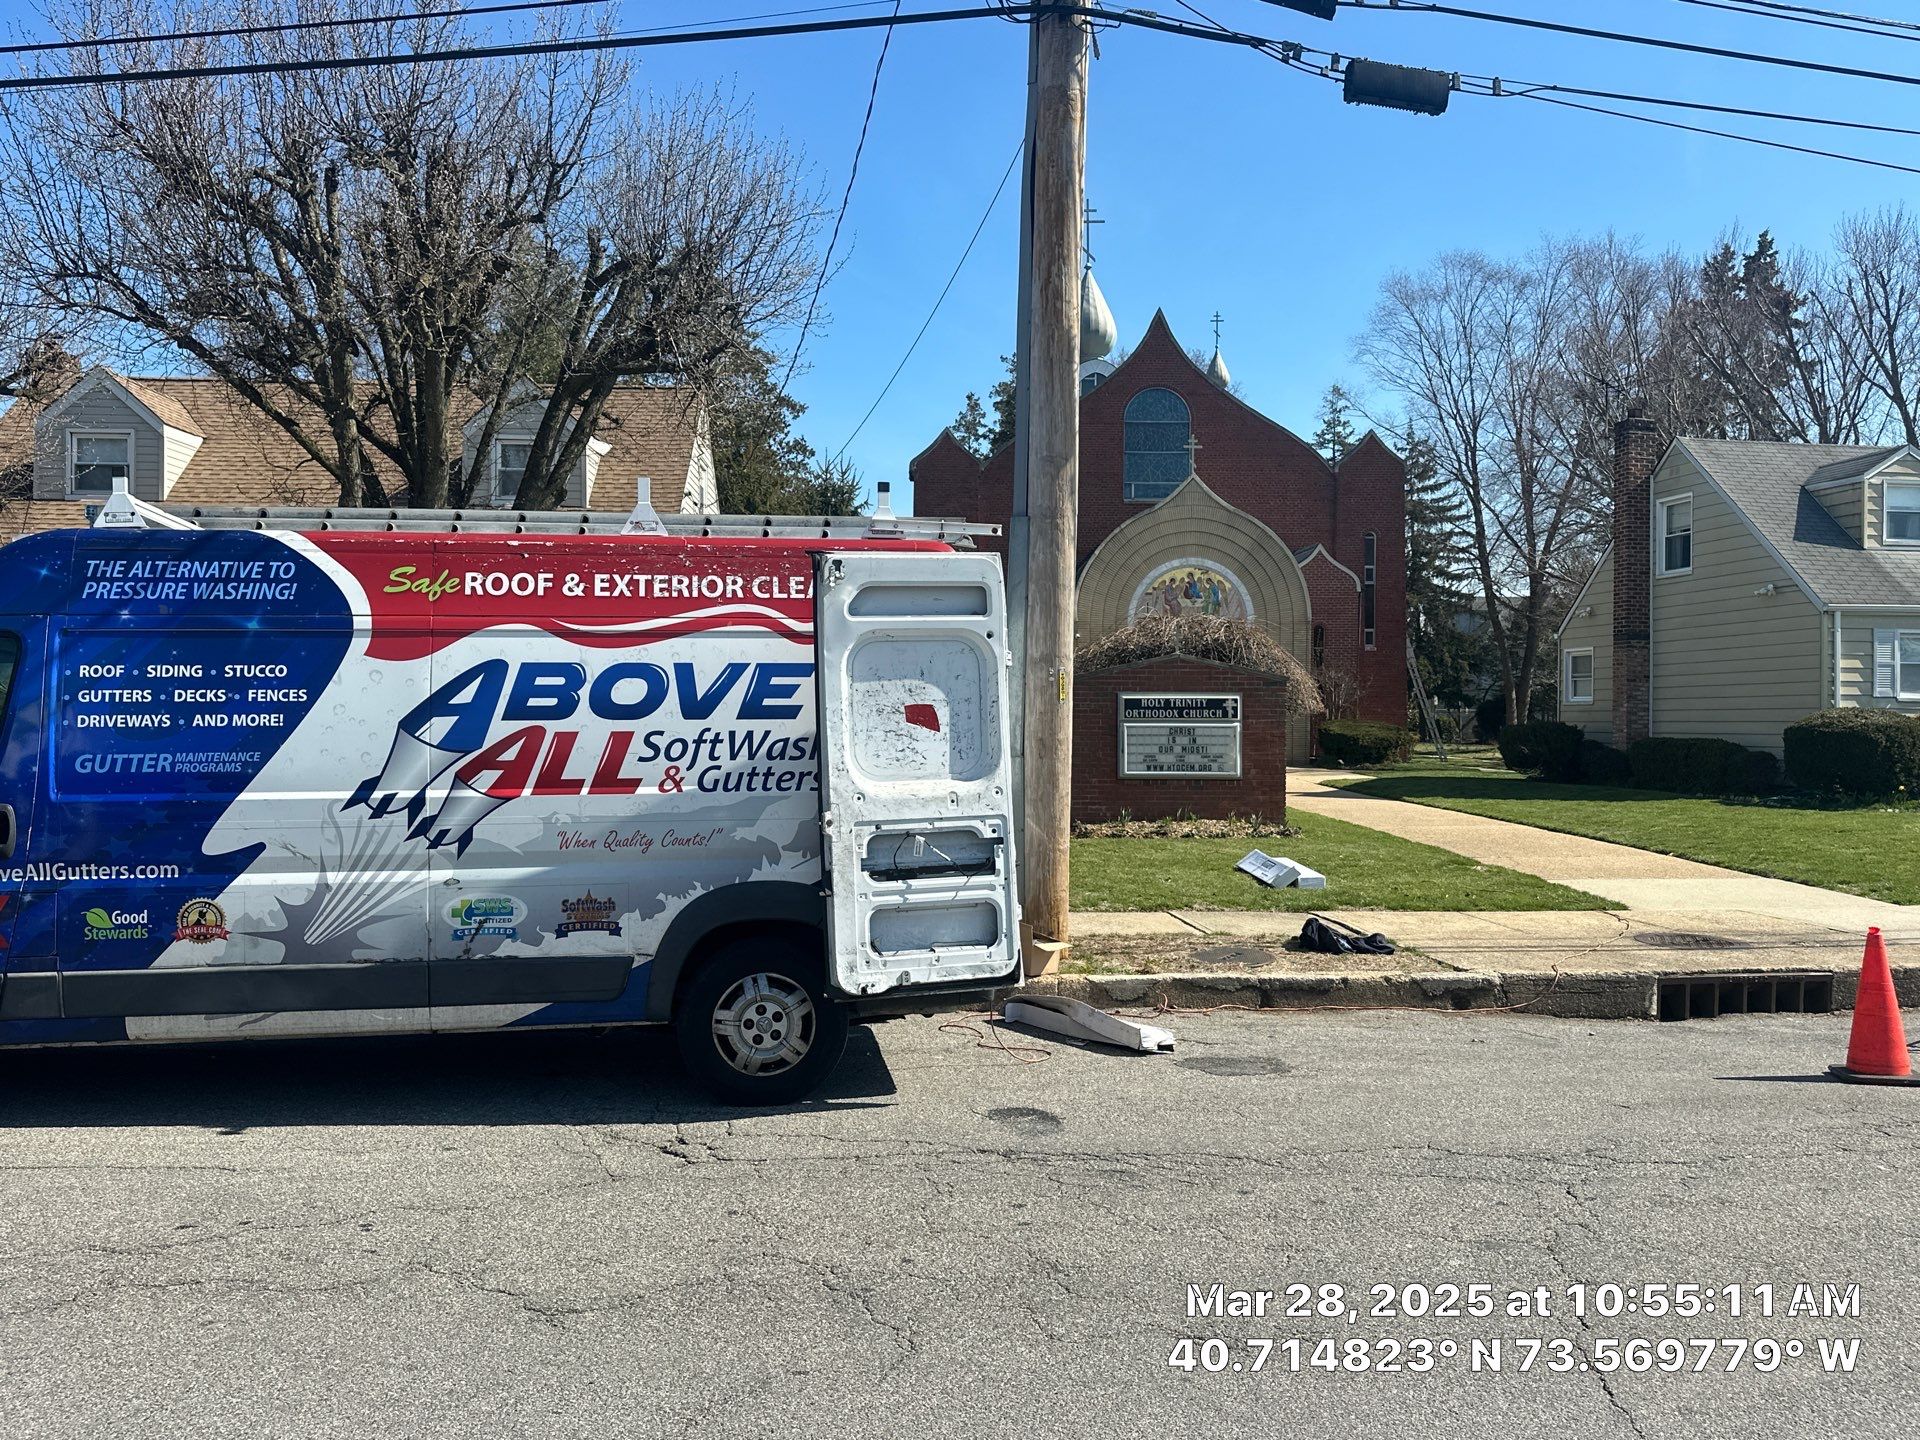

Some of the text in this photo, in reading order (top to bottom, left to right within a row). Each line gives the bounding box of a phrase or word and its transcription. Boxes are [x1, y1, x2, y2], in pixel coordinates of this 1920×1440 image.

[86, 560, 296, 579] THE ALTERNATIVE TO
[82, 581, 298, 600] PRESSURE WASHING!
[383, 566, 461, 601] Safe
[464, 572, 554, 596] ROOF
[561, 573, 587, 597] &
[594, 573, 744, 598] EXTERIOR
[79, 664, 288, 678] ROOF SIDING STUCCO
[77, 688, 308, 703] GUTTERS DECKS FENCES
[1141, 698, 1208, 707] HOLY TRINITY
[399, 658, 815, 754] ABOVE
[1125, 709, 1222, 718] ORTHODOX CHURCH
[77, 713, 284, 728] DRIVEWAYS AND MORE!
[1168, 727, 1196, 736] CHRIST
[74, 752, 173, 774] GUTTER
[175, 751, 262, 762] MAINTENANCE
[454, 724, 643, 798] ALL
[175, 762, 242, 773] PROGRAMS
[657, 765, 820, 793] & Gutters
[556, 830, 597, 850] "When
[603, 829, 654, 854] Quality
[472, 897, 512, 913] SWS
[561, 896, 617, 913] SoftWash
[111, 909, 148, 925] Good
[84, 925, 149, 941] Stewards
[561, 922, 616, 931] CERTIFIED
